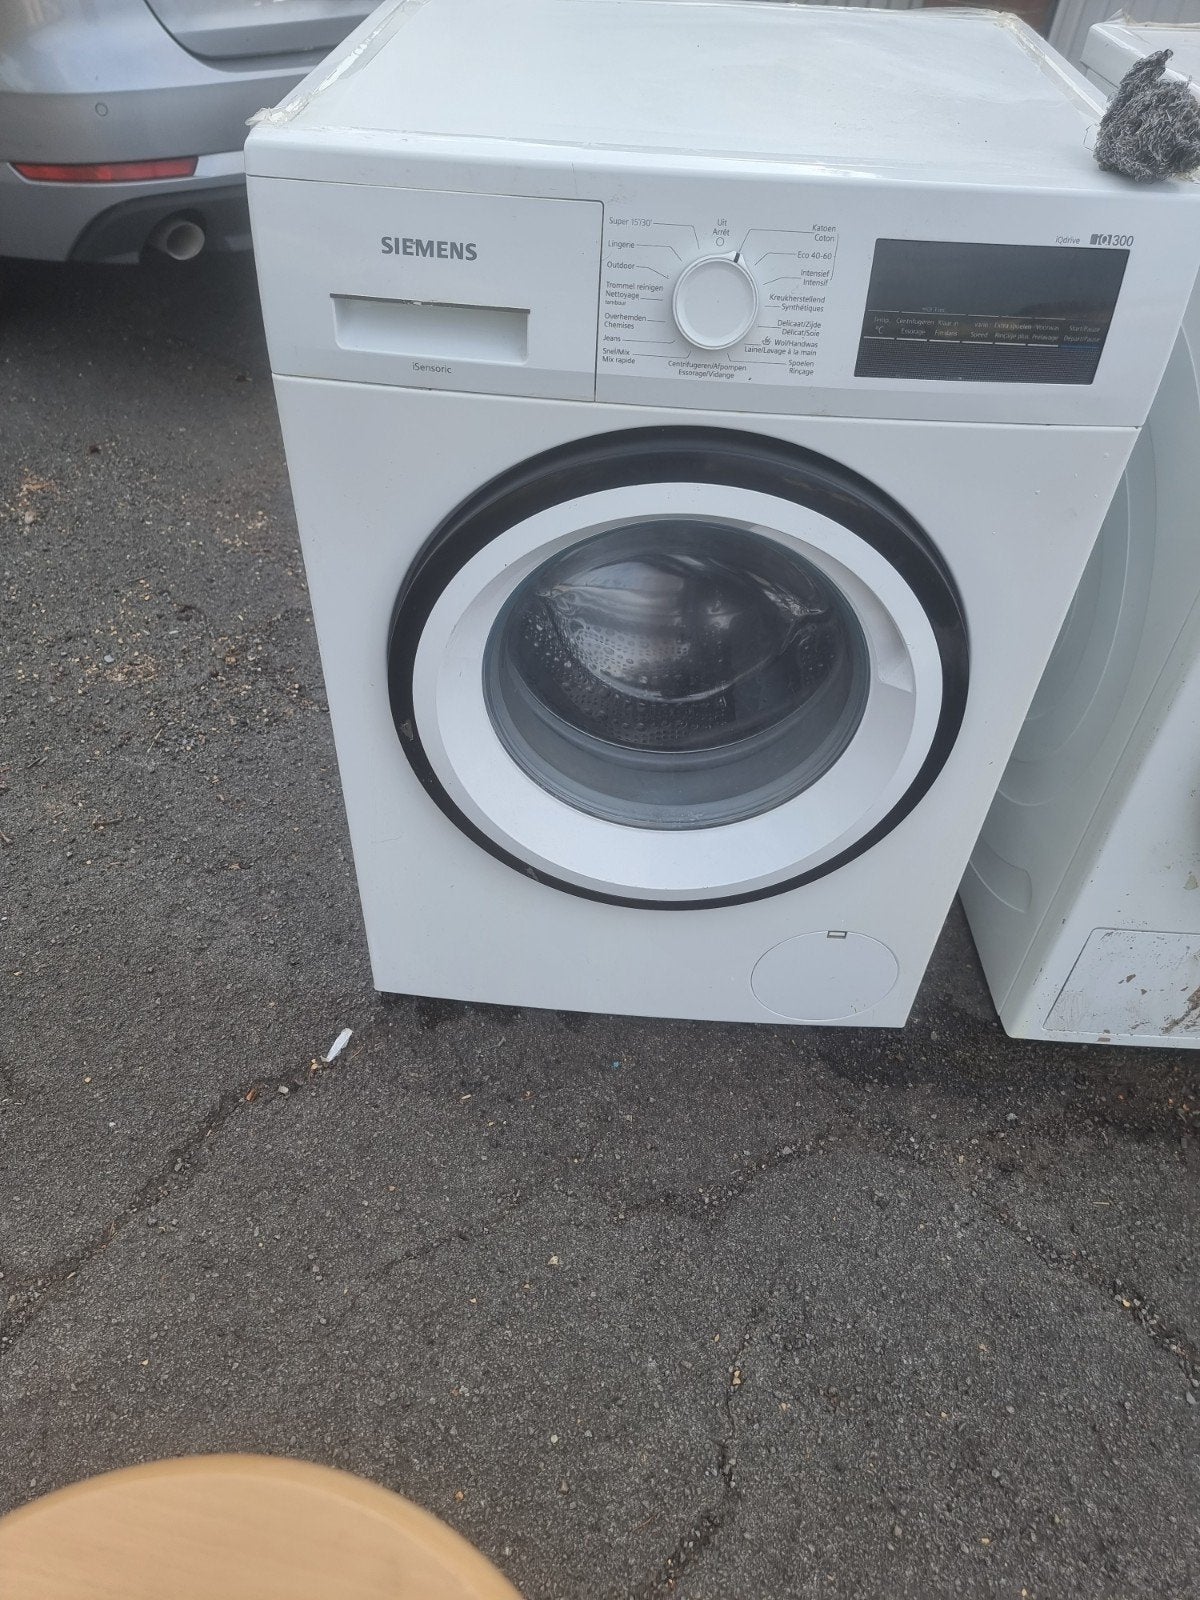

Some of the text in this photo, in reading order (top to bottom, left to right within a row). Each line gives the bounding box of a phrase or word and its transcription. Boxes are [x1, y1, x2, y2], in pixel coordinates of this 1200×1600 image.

[609, 217, 629, 227] Super
[717, 219, 727, 227] Uit
[812, 224, 836, 233] Katoen
[814, 234, 834, 242] Coton
[381, 236, 477, 261] SIEMENS
[608, 240, 635, 249] Lingerie
[797, 251, 832, 260] Eco 40-60
[607, 261, 635, 269] Outdoor
[801, 270, 830, 278] Intensief
[606, 281, 664, 292] Trommel reinigen
[803, 279, 828, 287] Intensif
[605, 290, 640, 300] Nettoyage
[769, 293, 826, 303] Kreukherstellend
[781, 303, 824, 313] Synthétiques
[604, 312, 647, 321] Overhemden
[604, 321, 634, 330] Chemises
[778, 320, 821, 330] Delicaat/Zijde
[781, 328, 820, 337] Délicat/Soie
[603, 334, 621, 342] Jeans
[774, 339, 818, 348] Wol/Handwas
[603, 347, 630, 356] Snel/Mix
[744, 346, 786, 356] Laine/Lavage
[616, 356, 636, 364] rapide
[788, 360, 815, 368] Spoelen
[412, 362, 452, 374] iSensoric
[668, 360, 747, 372] Centrifugeren/Afpompen
[678, 368, 735, 379] Essorage/Vidange
[789, 367, 814, 377] Rinçage
